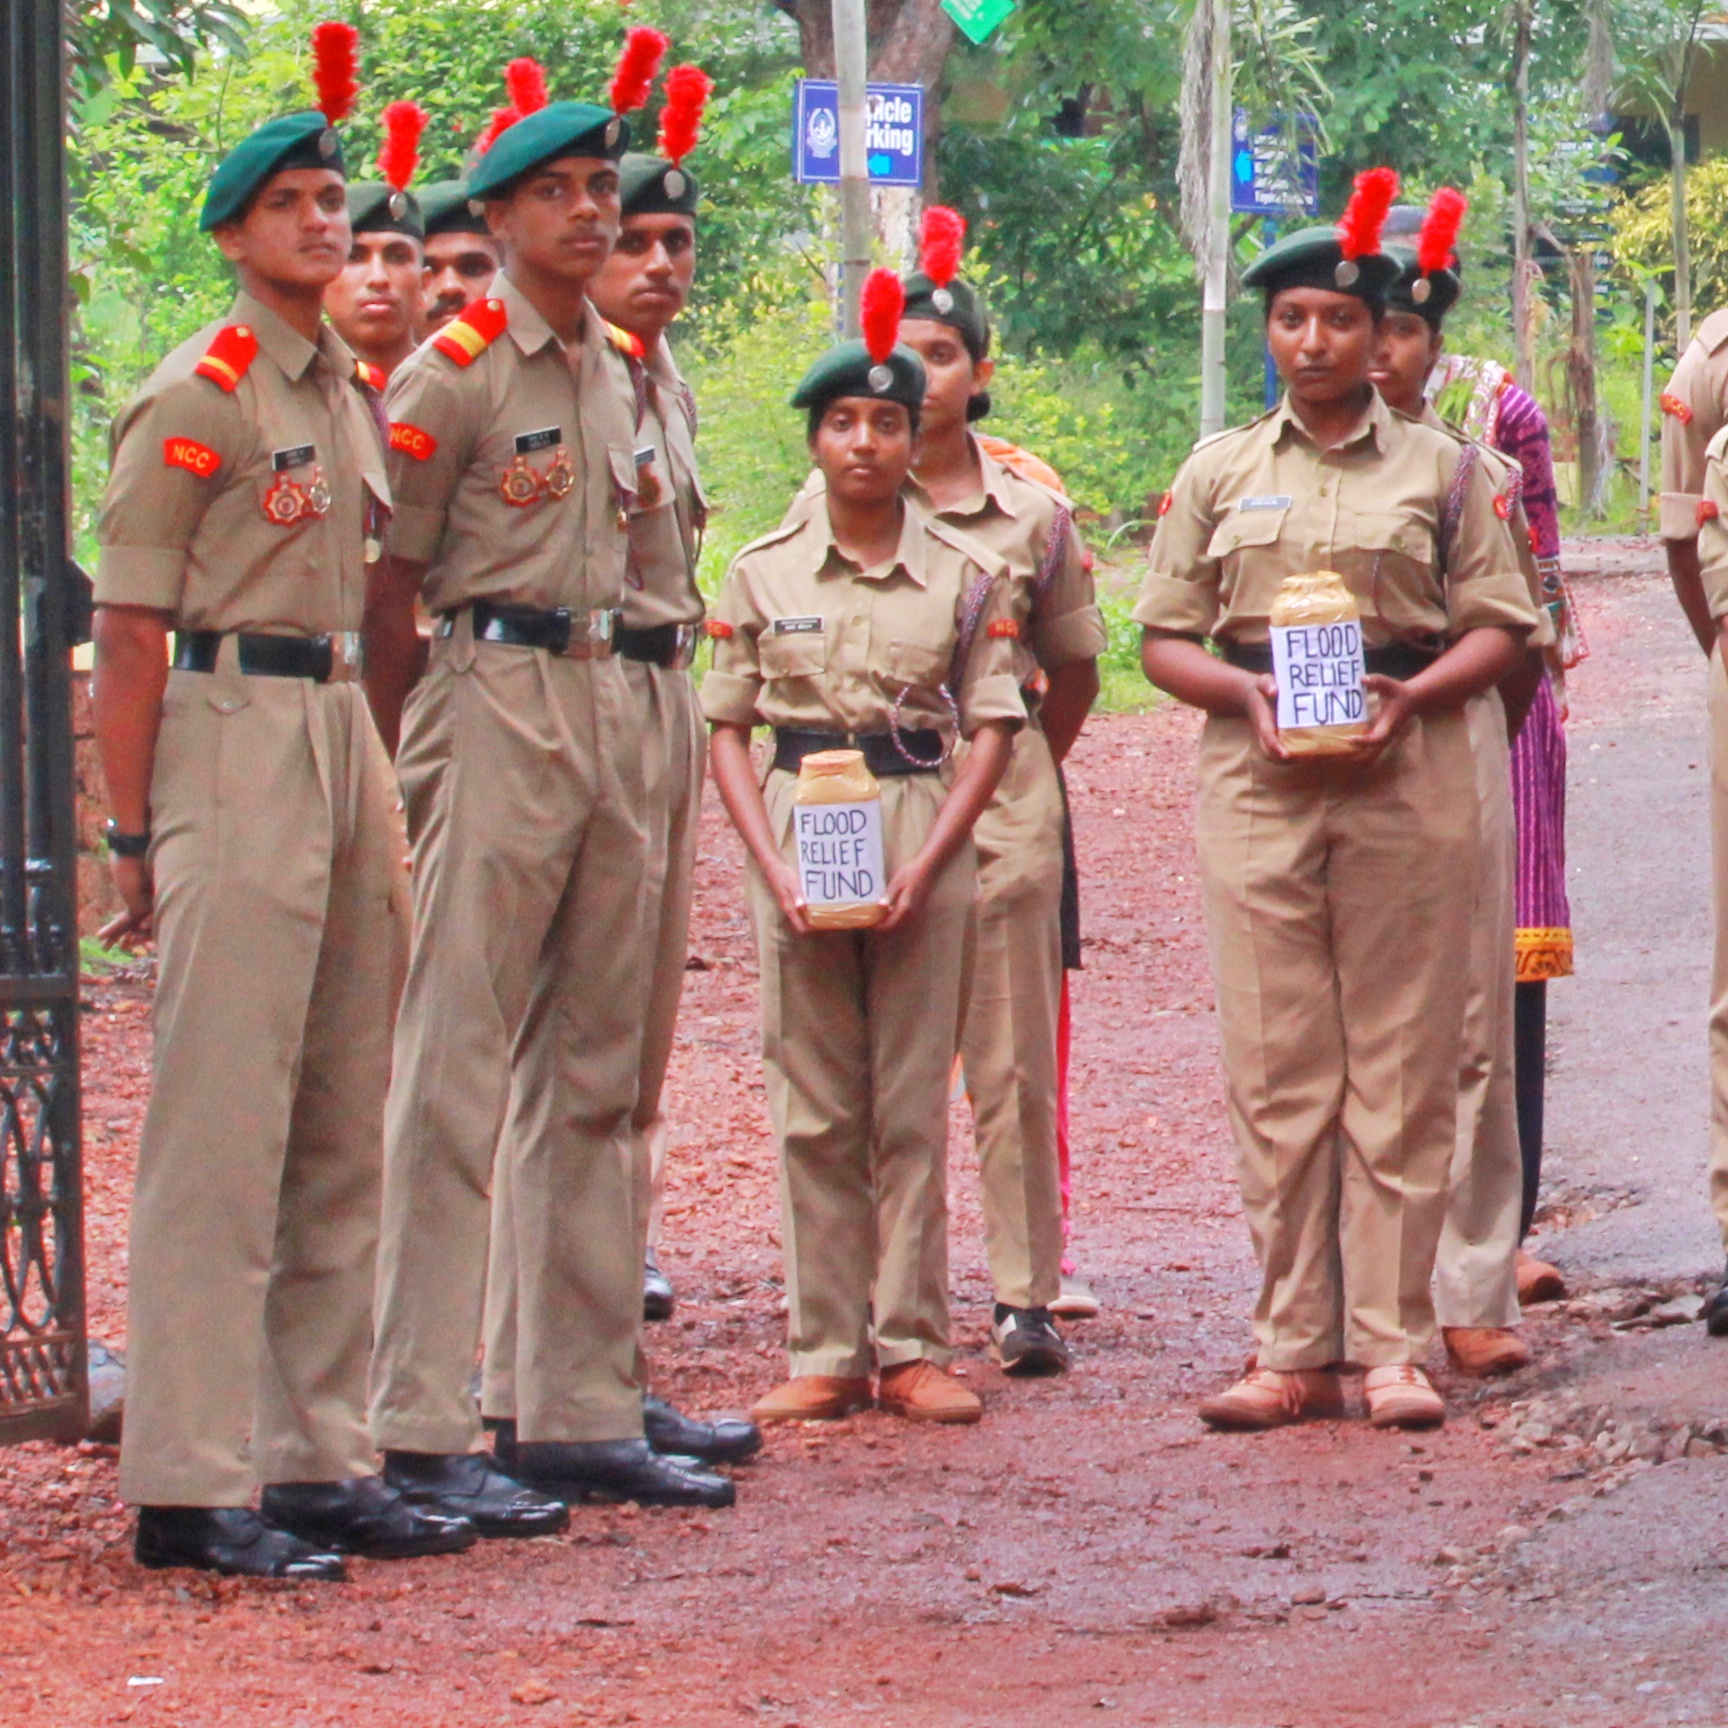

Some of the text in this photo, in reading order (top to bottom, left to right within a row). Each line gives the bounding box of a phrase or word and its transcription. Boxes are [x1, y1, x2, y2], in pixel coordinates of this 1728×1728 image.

[390, 427, 425, 451] NCC
[173, 444, 210, 470] NCC
[1286, 624, 1359, 659] FLOOD
[1289, 659, 1360, 690] RELIEF
[1293, 689, 1363, 726] FUND
[800, 809, 867, 836] FLOOD
[800, 837, 867, 867] RELIEF
[805, 869, 874, 900] FUND
